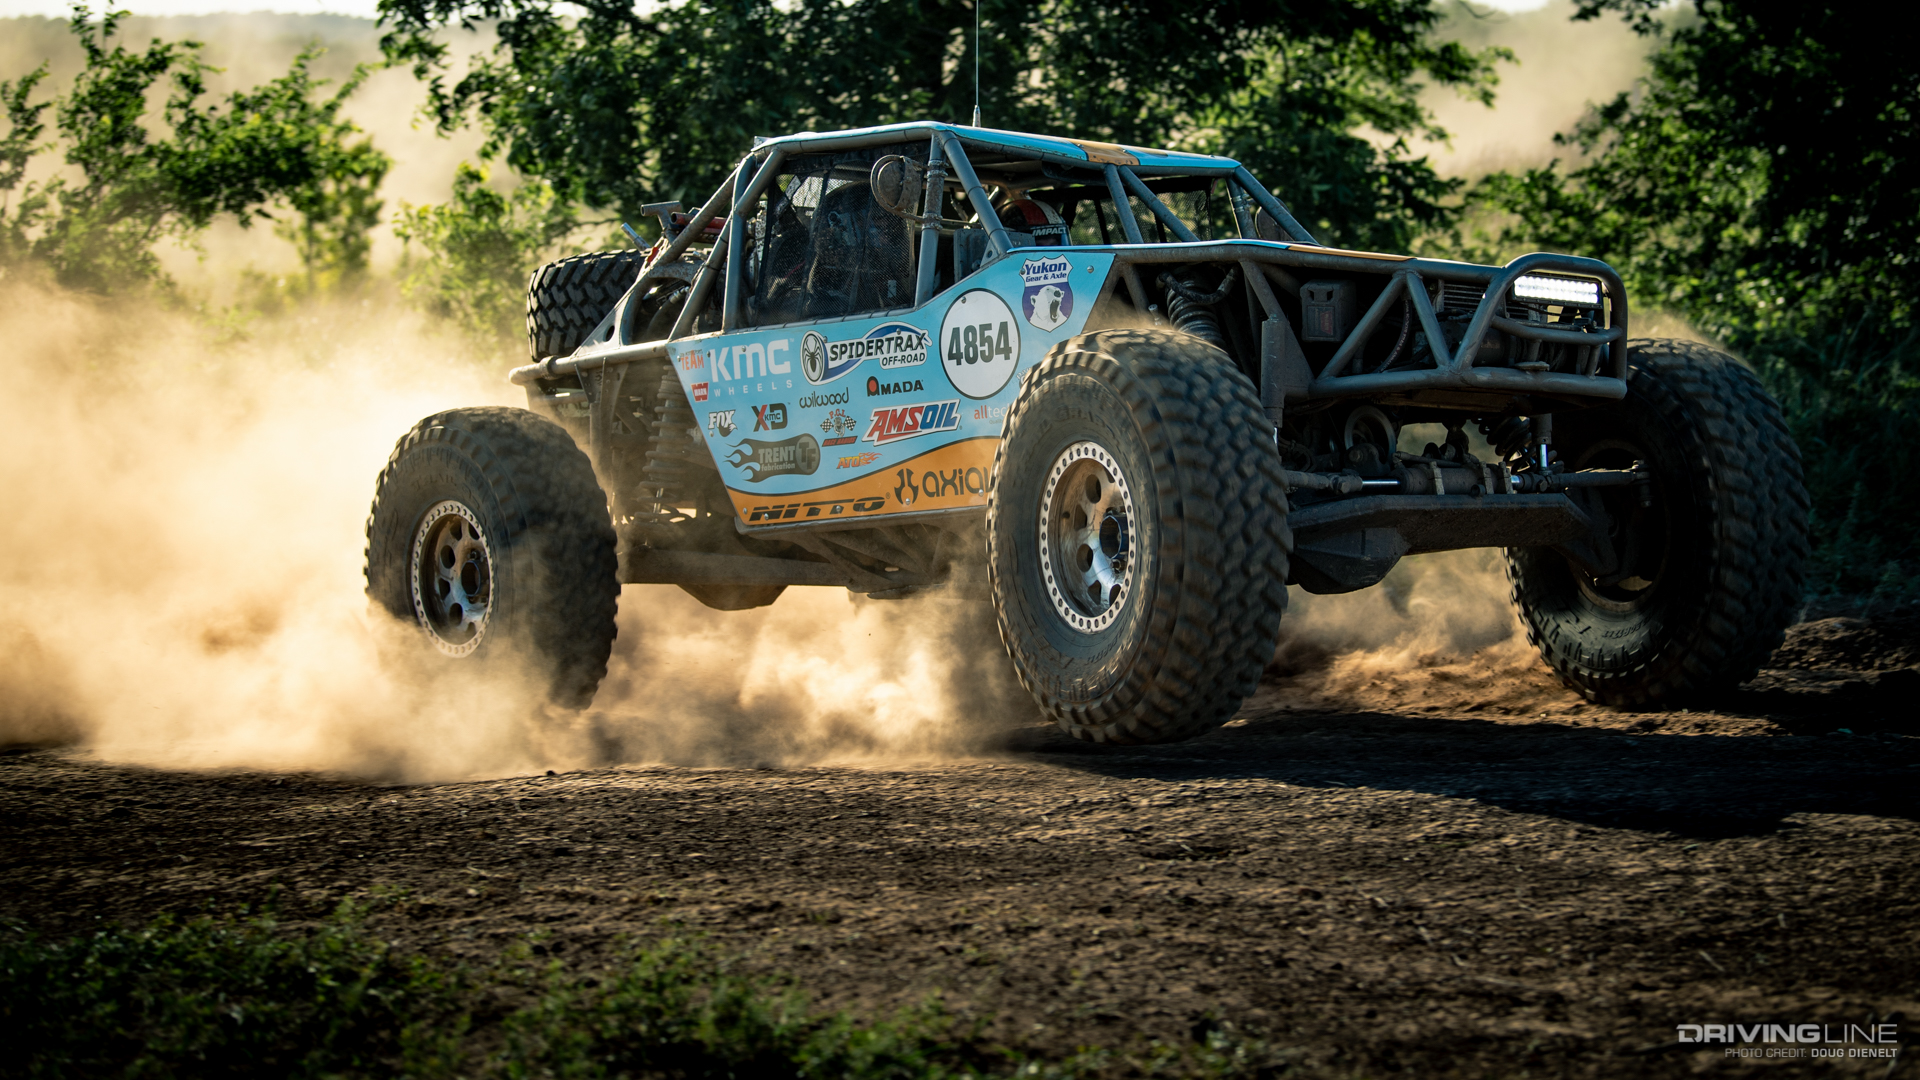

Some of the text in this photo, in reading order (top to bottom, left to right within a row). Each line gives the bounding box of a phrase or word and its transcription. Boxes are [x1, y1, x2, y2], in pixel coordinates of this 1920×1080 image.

[1032, 227, 1067, 237] IMPACT
[1025, 262, 1067, 275] Yukon
[1050, 272, 1067, 280] Axle
[829, 332, 927, 362] SPIDERTRAX
[948, 321, 1013, 366] 4854
[681, 350, 704, 371] TEAM
[881, 352, 926, 367] OFF-ROAD
[713, 380, 793, 398] WHEELS
[867, 376, 924, 397] AMADA
[799, 387, 850, 409] wilwood
[708, 409, 736, 430] FOX
[751, 402, 788, 433] XD
[867, 401, 958, 442] AMSOIL
[973, 403, 1010, 420] alltec
[758, 446, 795, 464] TRENT
[761, 462, 796, 472] fabrication
[922, 465, 993, 498] axial
[749, 497, 885, 522] NITTO
